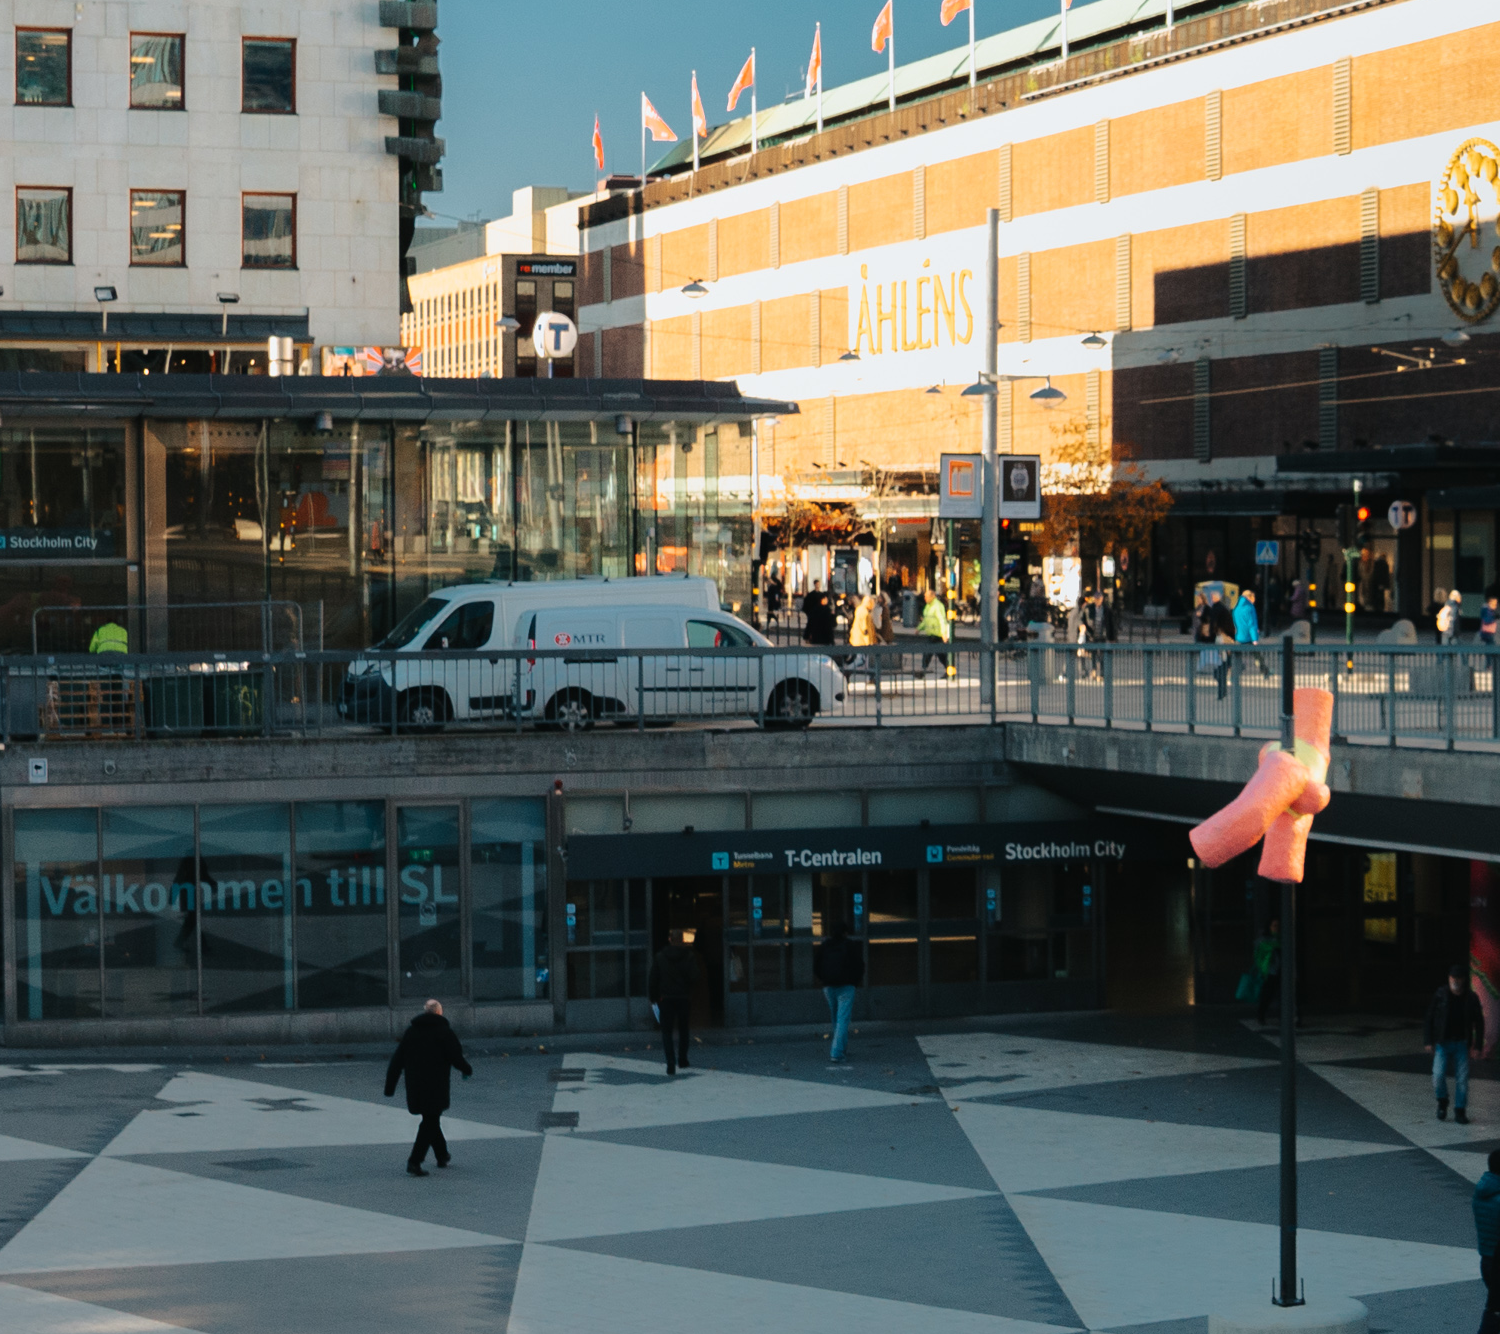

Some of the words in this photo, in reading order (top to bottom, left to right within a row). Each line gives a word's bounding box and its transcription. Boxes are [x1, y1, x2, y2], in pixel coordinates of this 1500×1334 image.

[855, 258, 974, 355] ÅHLÉNS
[548, 322, 570, 352] T
[10, 536, 72, 550] Stockholm
[74, 535, 98, 551] City
[573, 633, 606, 645] MTR
[784, 847, 883, 868] T-Centralen
[1005, 840, 1092, 861] Stockholm
[1094, 839, 1127, 860] City
[40, 871, 313, 916] Välkommen
[326, 865, 386, 907] till
[400, 863, 459, 905] SL
